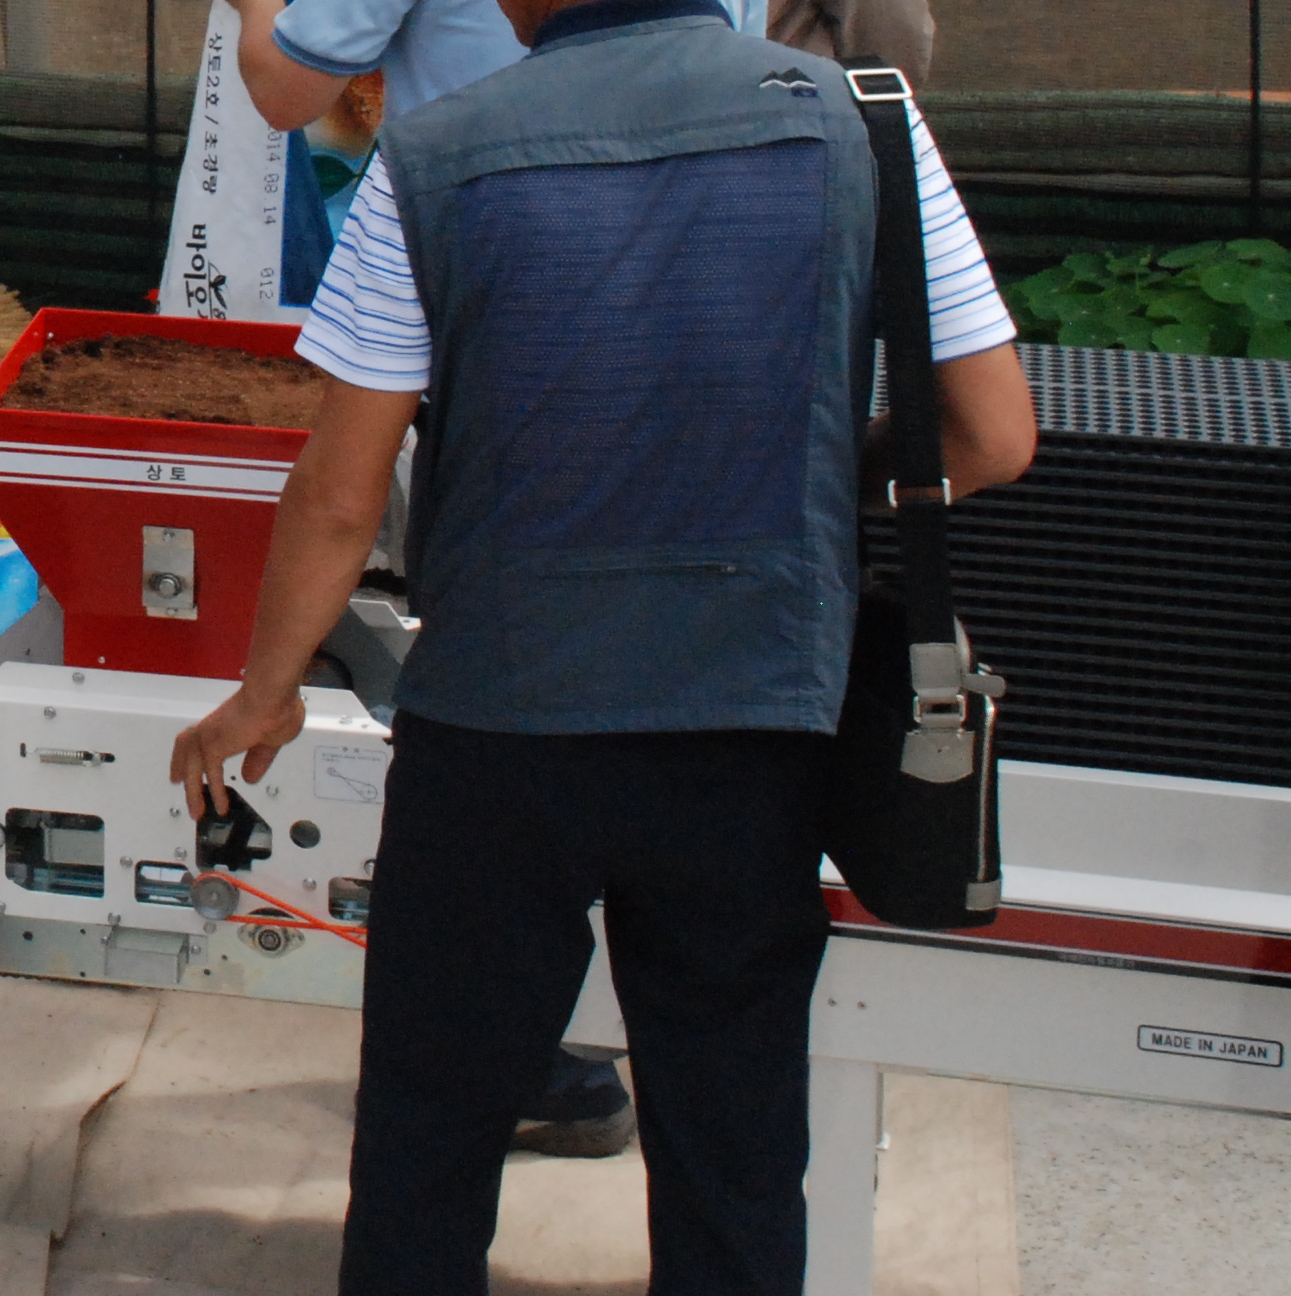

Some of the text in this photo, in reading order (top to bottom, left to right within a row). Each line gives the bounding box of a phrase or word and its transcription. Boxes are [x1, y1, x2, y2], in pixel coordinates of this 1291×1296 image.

[1151, 1032, 1268, 1059] MADE IN JAPAN
